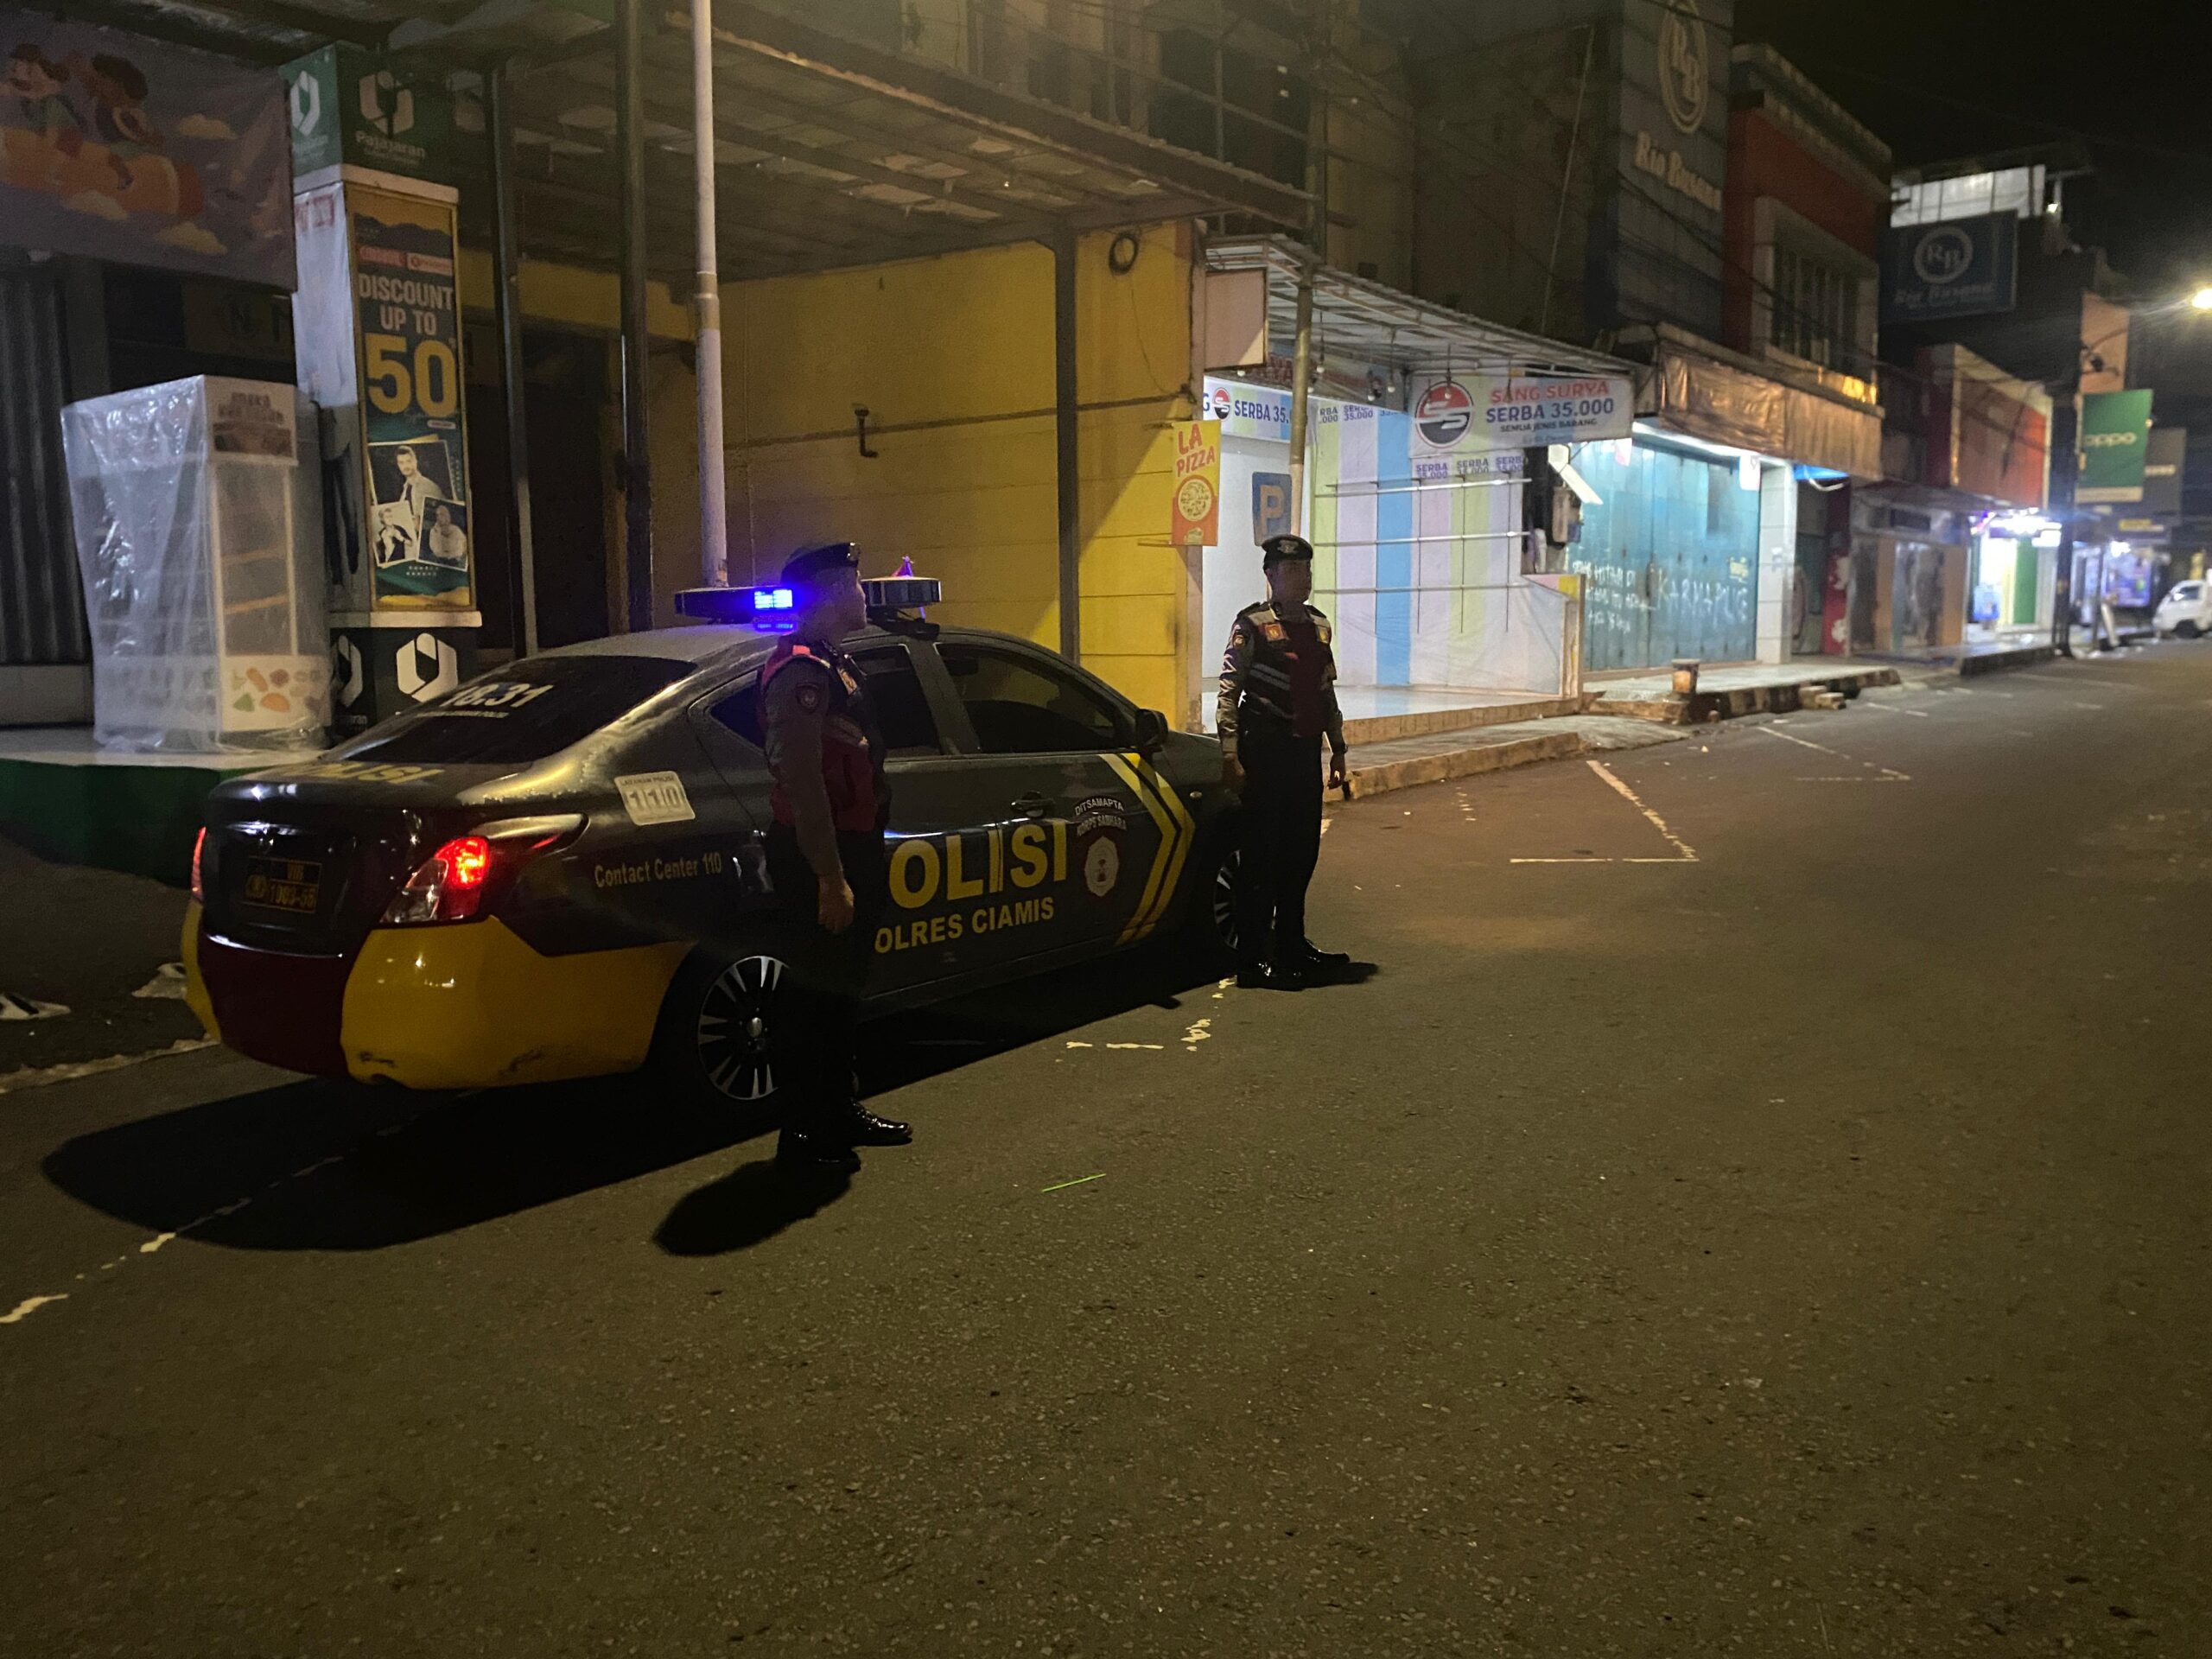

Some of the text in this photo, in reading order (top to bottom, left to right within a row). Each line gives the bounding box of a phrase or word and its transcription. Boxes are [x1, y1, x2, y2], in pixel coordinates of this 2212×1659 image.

[358, 273, 454, 311] DISCOUNT
[380, 306, 437, 336] UP TO
[1491, 380, 1611, 405] SANG SURYA
[1234, 399, 1271, 422] SERBA
[1274, 405, 1290, 424] 35.
[1319, 406, 1338, 416] RBA
[1486, 397, 1614, 423] SERBA 35.000
[1178, 423, 1203, 454] LA
[1176, 445, 1216, 477] PIZZA
[1457, 457, 1490, 469] SERBA
[1496, 455, 1522, 465] SERB
[1260, 485, 1286, 541] P
[628, 785, 683, 810] 110
[1074, 796, 1125, 817] DITSAMAPTA
[594, 851, 721, 888] Contact Center 110
[889, 820, 1068, 909] OLISI
[874, 896, 1055, 954] OLRES CIAMIS
